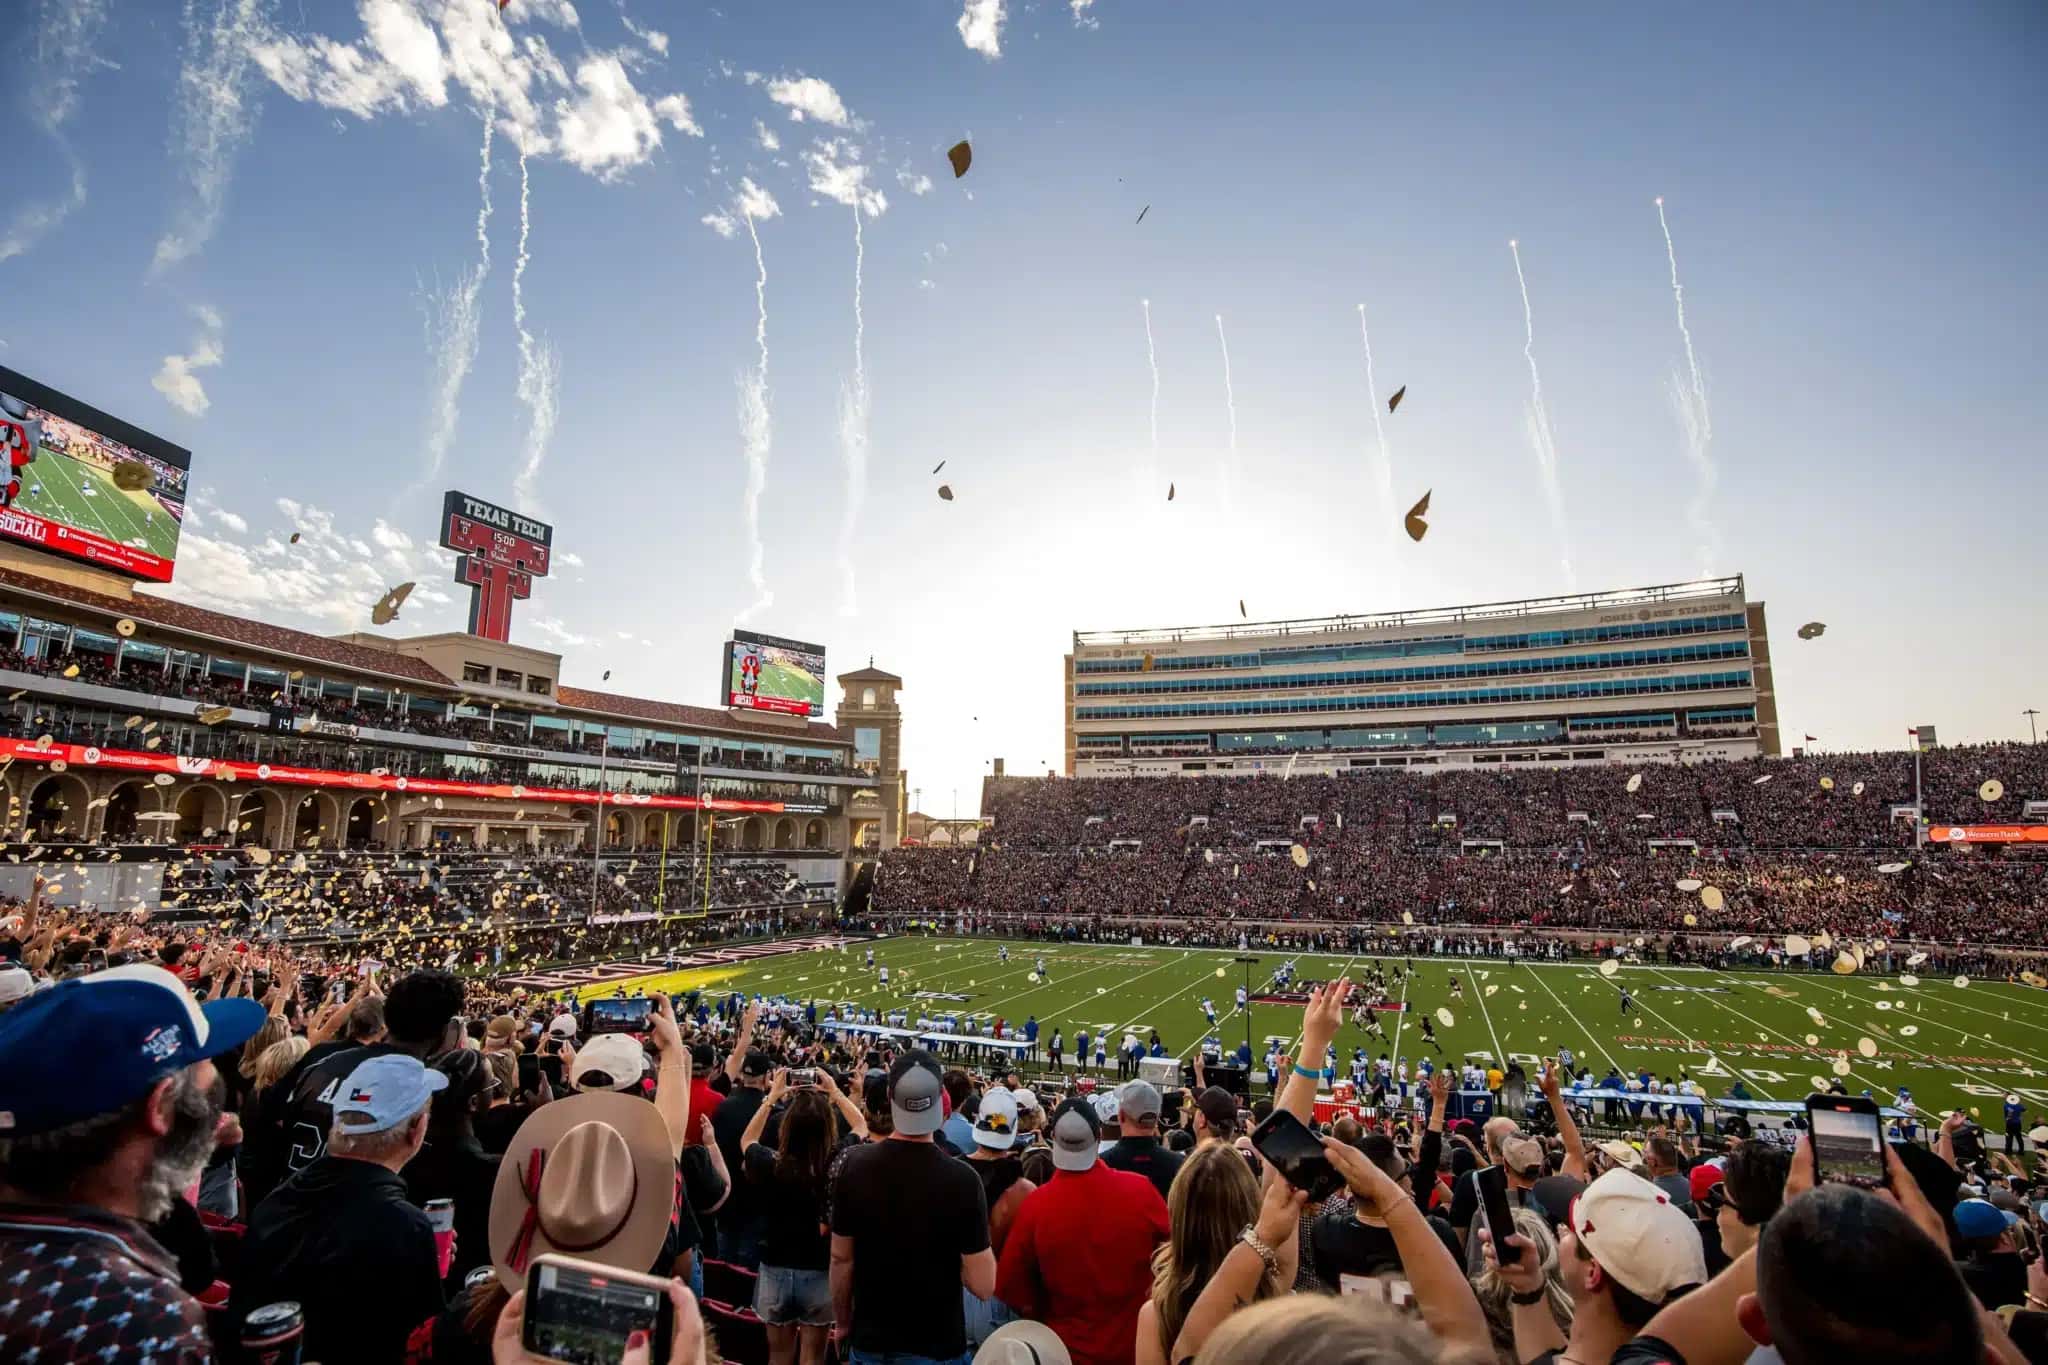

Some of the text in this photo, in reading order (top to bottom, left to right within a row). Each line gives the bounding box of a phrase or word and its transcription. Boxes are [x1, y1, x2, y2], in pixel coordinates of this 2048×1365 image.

[463, 498, 545, 540] TEXAS TECH
[462, 526, 468, 535] 0
[493, 532, 516, 547] 15:00
[1678, 603, 1732, 616] STADIUM
[278, 718, 290, 730] 14
